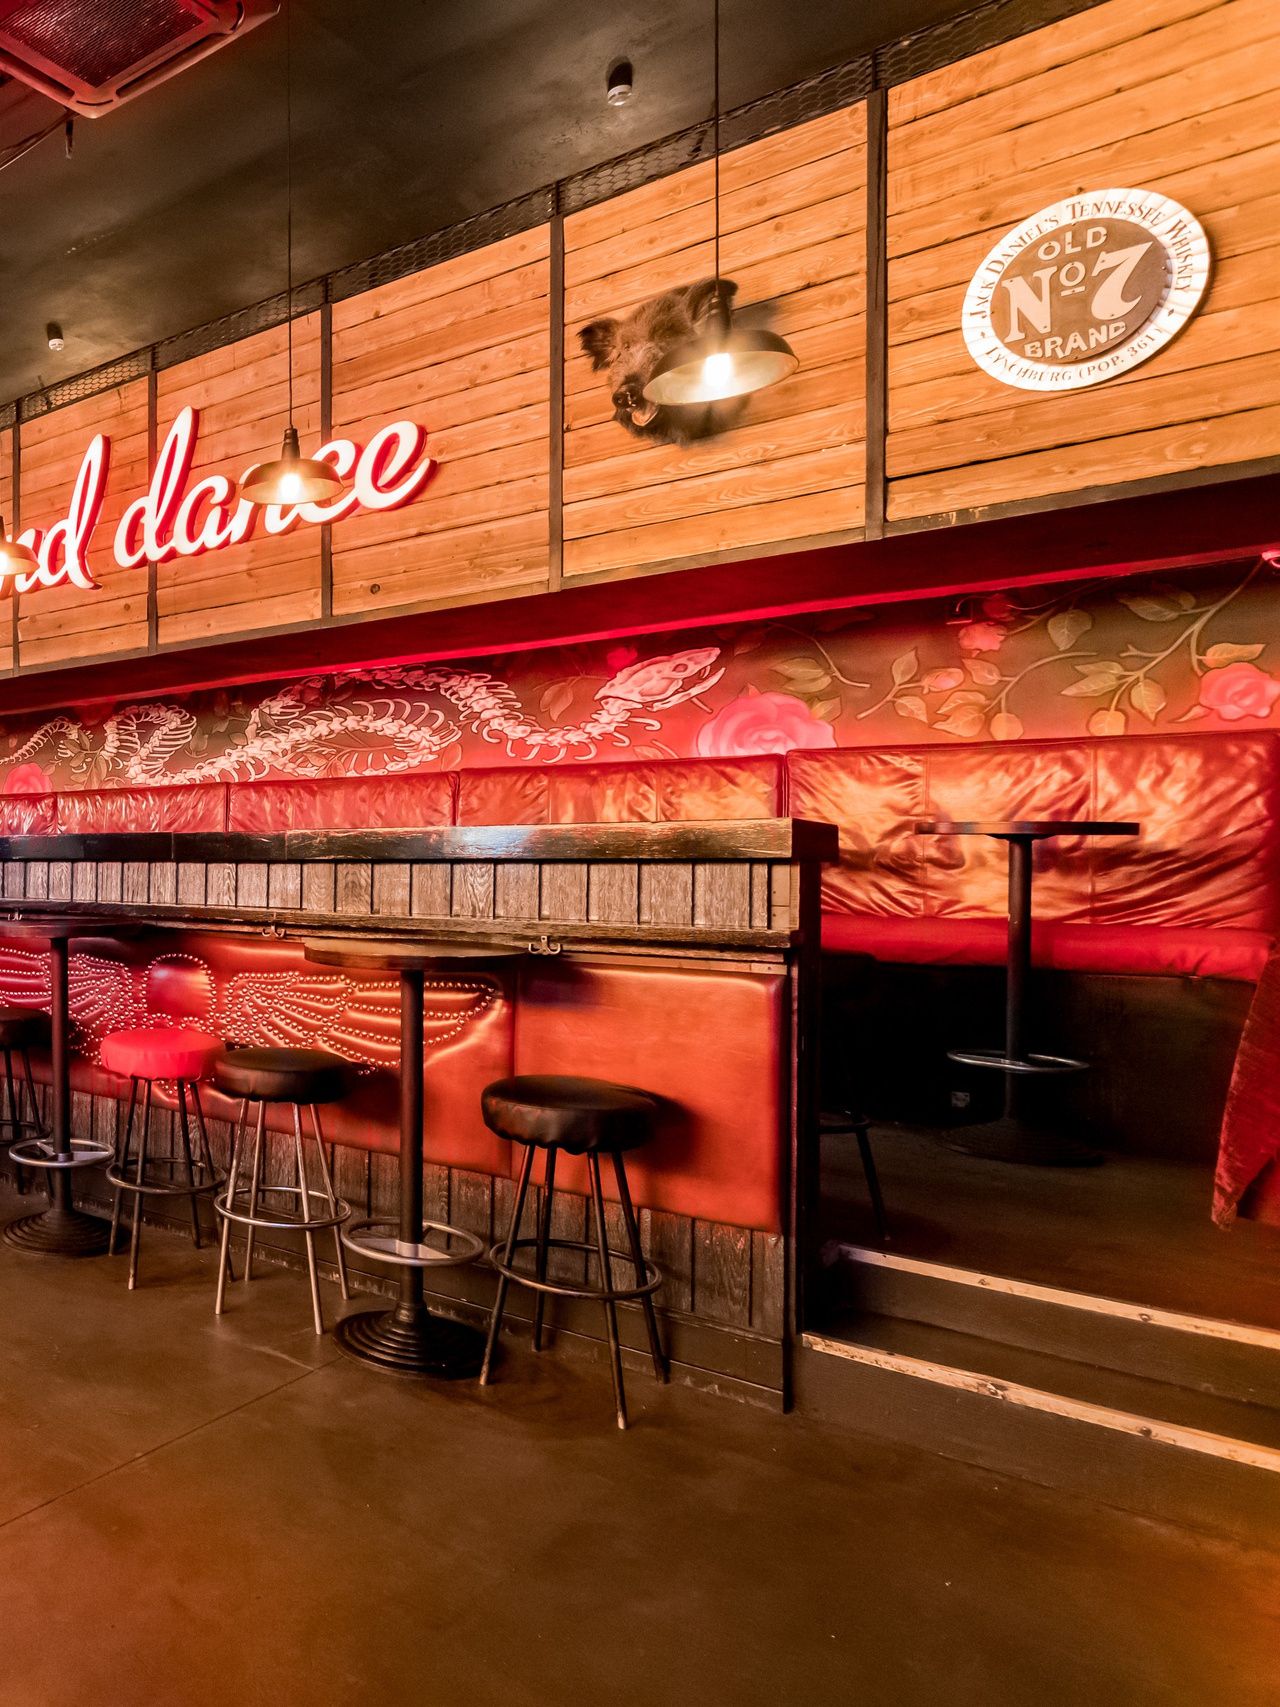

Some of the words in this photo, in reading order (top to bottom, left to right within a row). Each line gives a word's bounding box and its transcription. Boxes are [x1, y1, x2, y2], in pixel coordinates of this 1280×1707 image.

[970, 280, 996, 320] JACK
[985, 213, 1060, 275] DANIEL'S
[1065, 200, 1166, 226] TENNESSEE
[1165, 218, 1194, 294] WHISKEY
[1037, 225, 1108, 261] OLD
[1090, 240, 1154, 321] 7
[984, 346, 1073, 383] LYNCHBURG
[1078, 354, 1125, 380] (POP.
[1129, 327, 1165, 358] 361)
[1023, 321, 1127, 360] BRAND
[112, 404, 434, 569] dance
